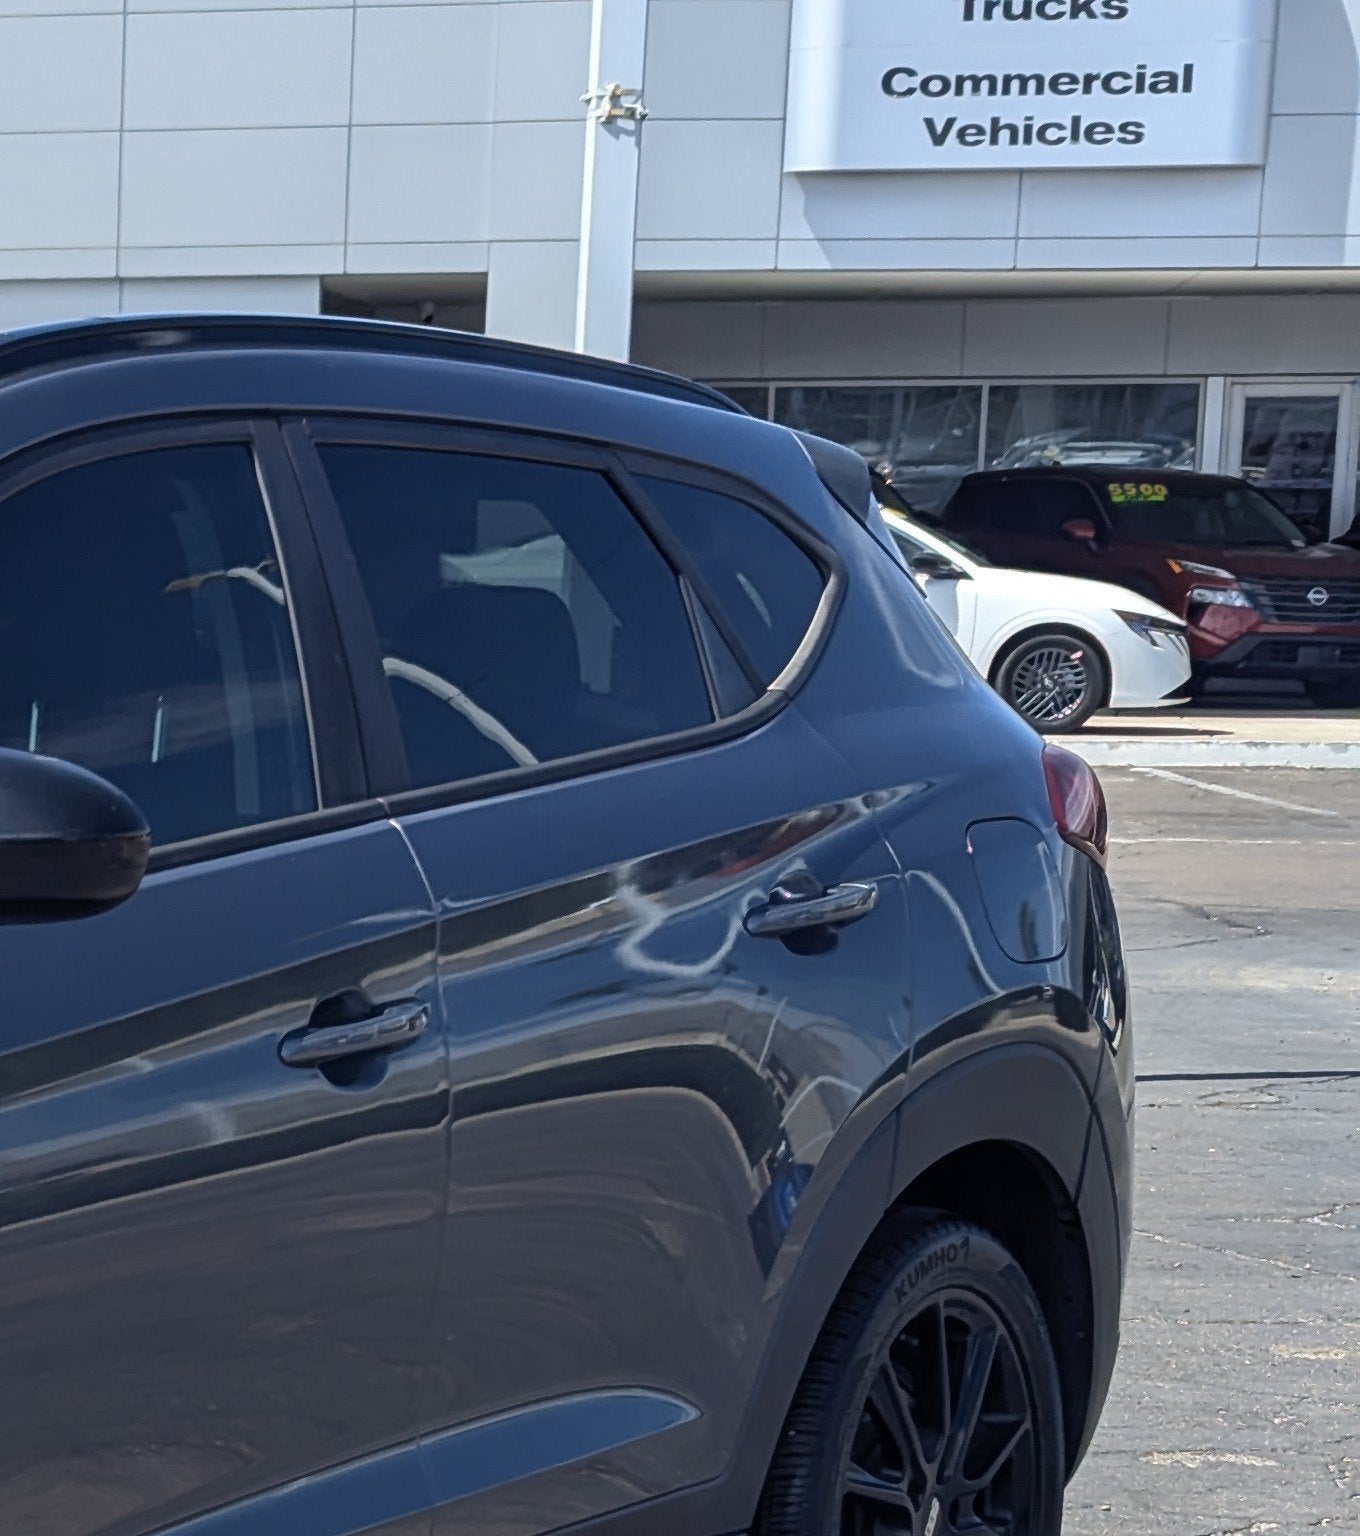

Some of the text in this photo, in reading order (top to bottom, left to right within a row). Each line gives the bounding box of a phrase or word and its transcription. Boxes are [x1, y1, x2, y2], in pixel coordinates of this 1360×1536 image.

[880, 63, 1195, 98] Commercial
[923, 115, 1146, 148] Vehicles
[895, 1242, 959, 1305] KUMHO
